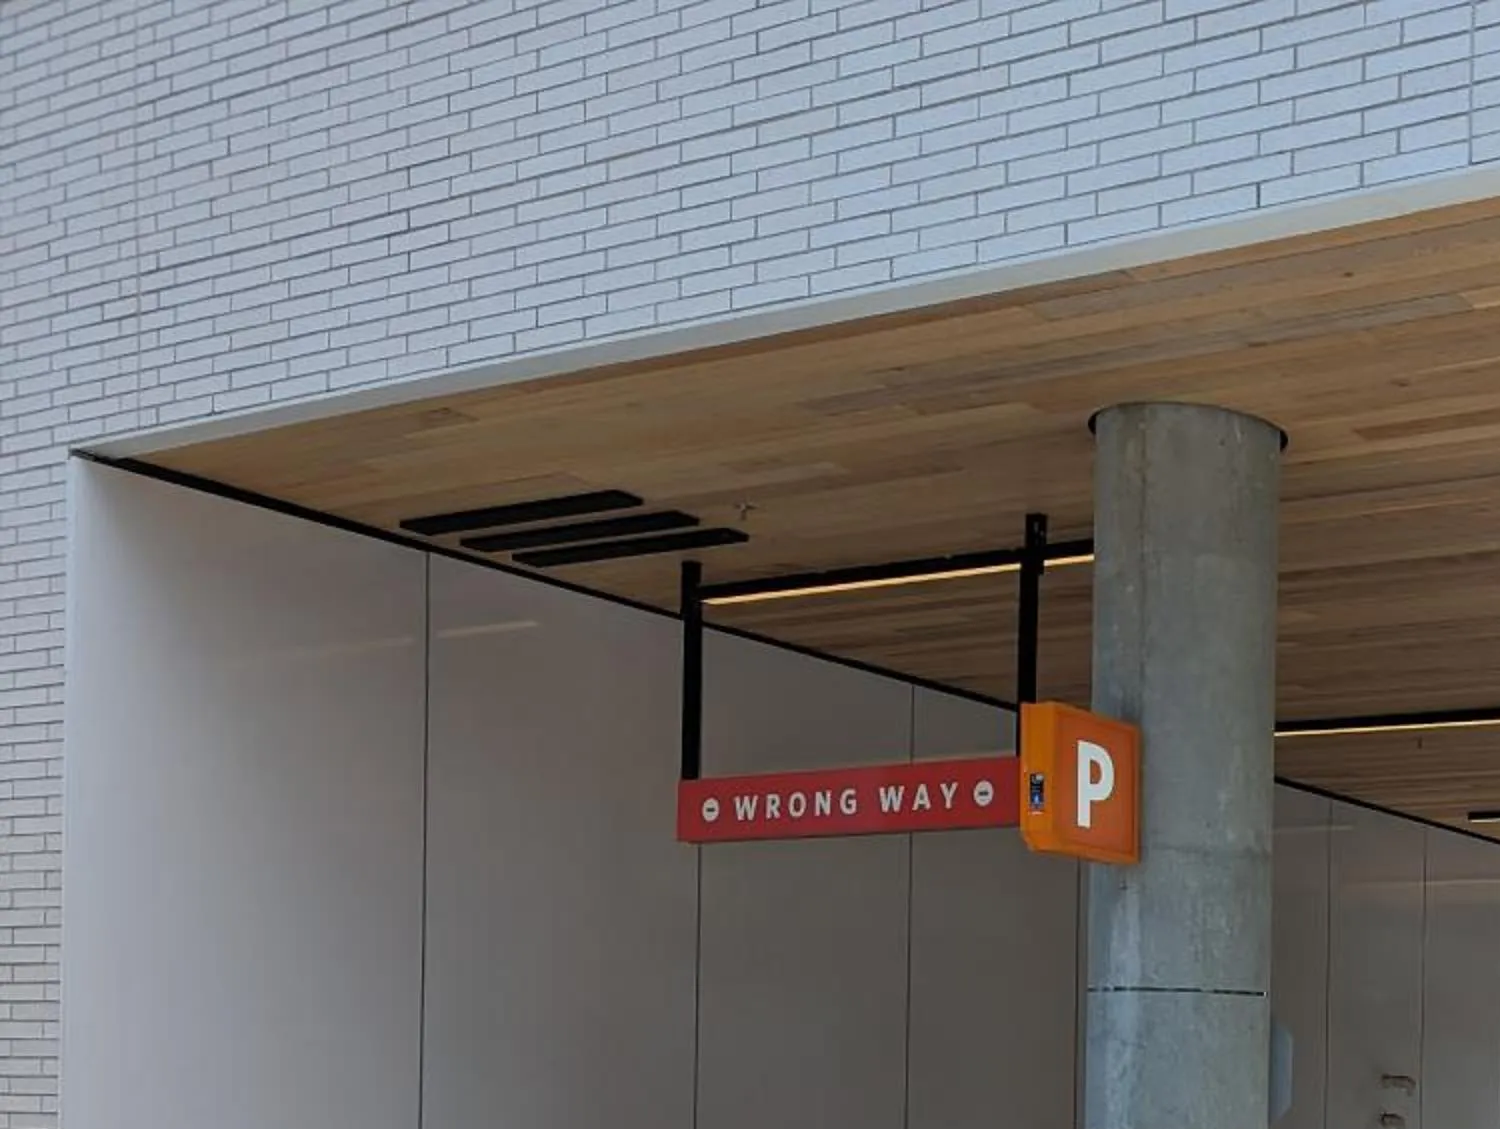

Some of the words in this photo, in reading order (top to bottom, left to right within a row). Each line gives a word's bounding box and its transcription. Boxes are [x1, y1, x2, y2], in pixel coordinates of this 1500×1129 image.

[734, 788, 857, 822] WRONG
[879, 781, 959, 813] WAY
[1077, 740, 1115, 828] P
